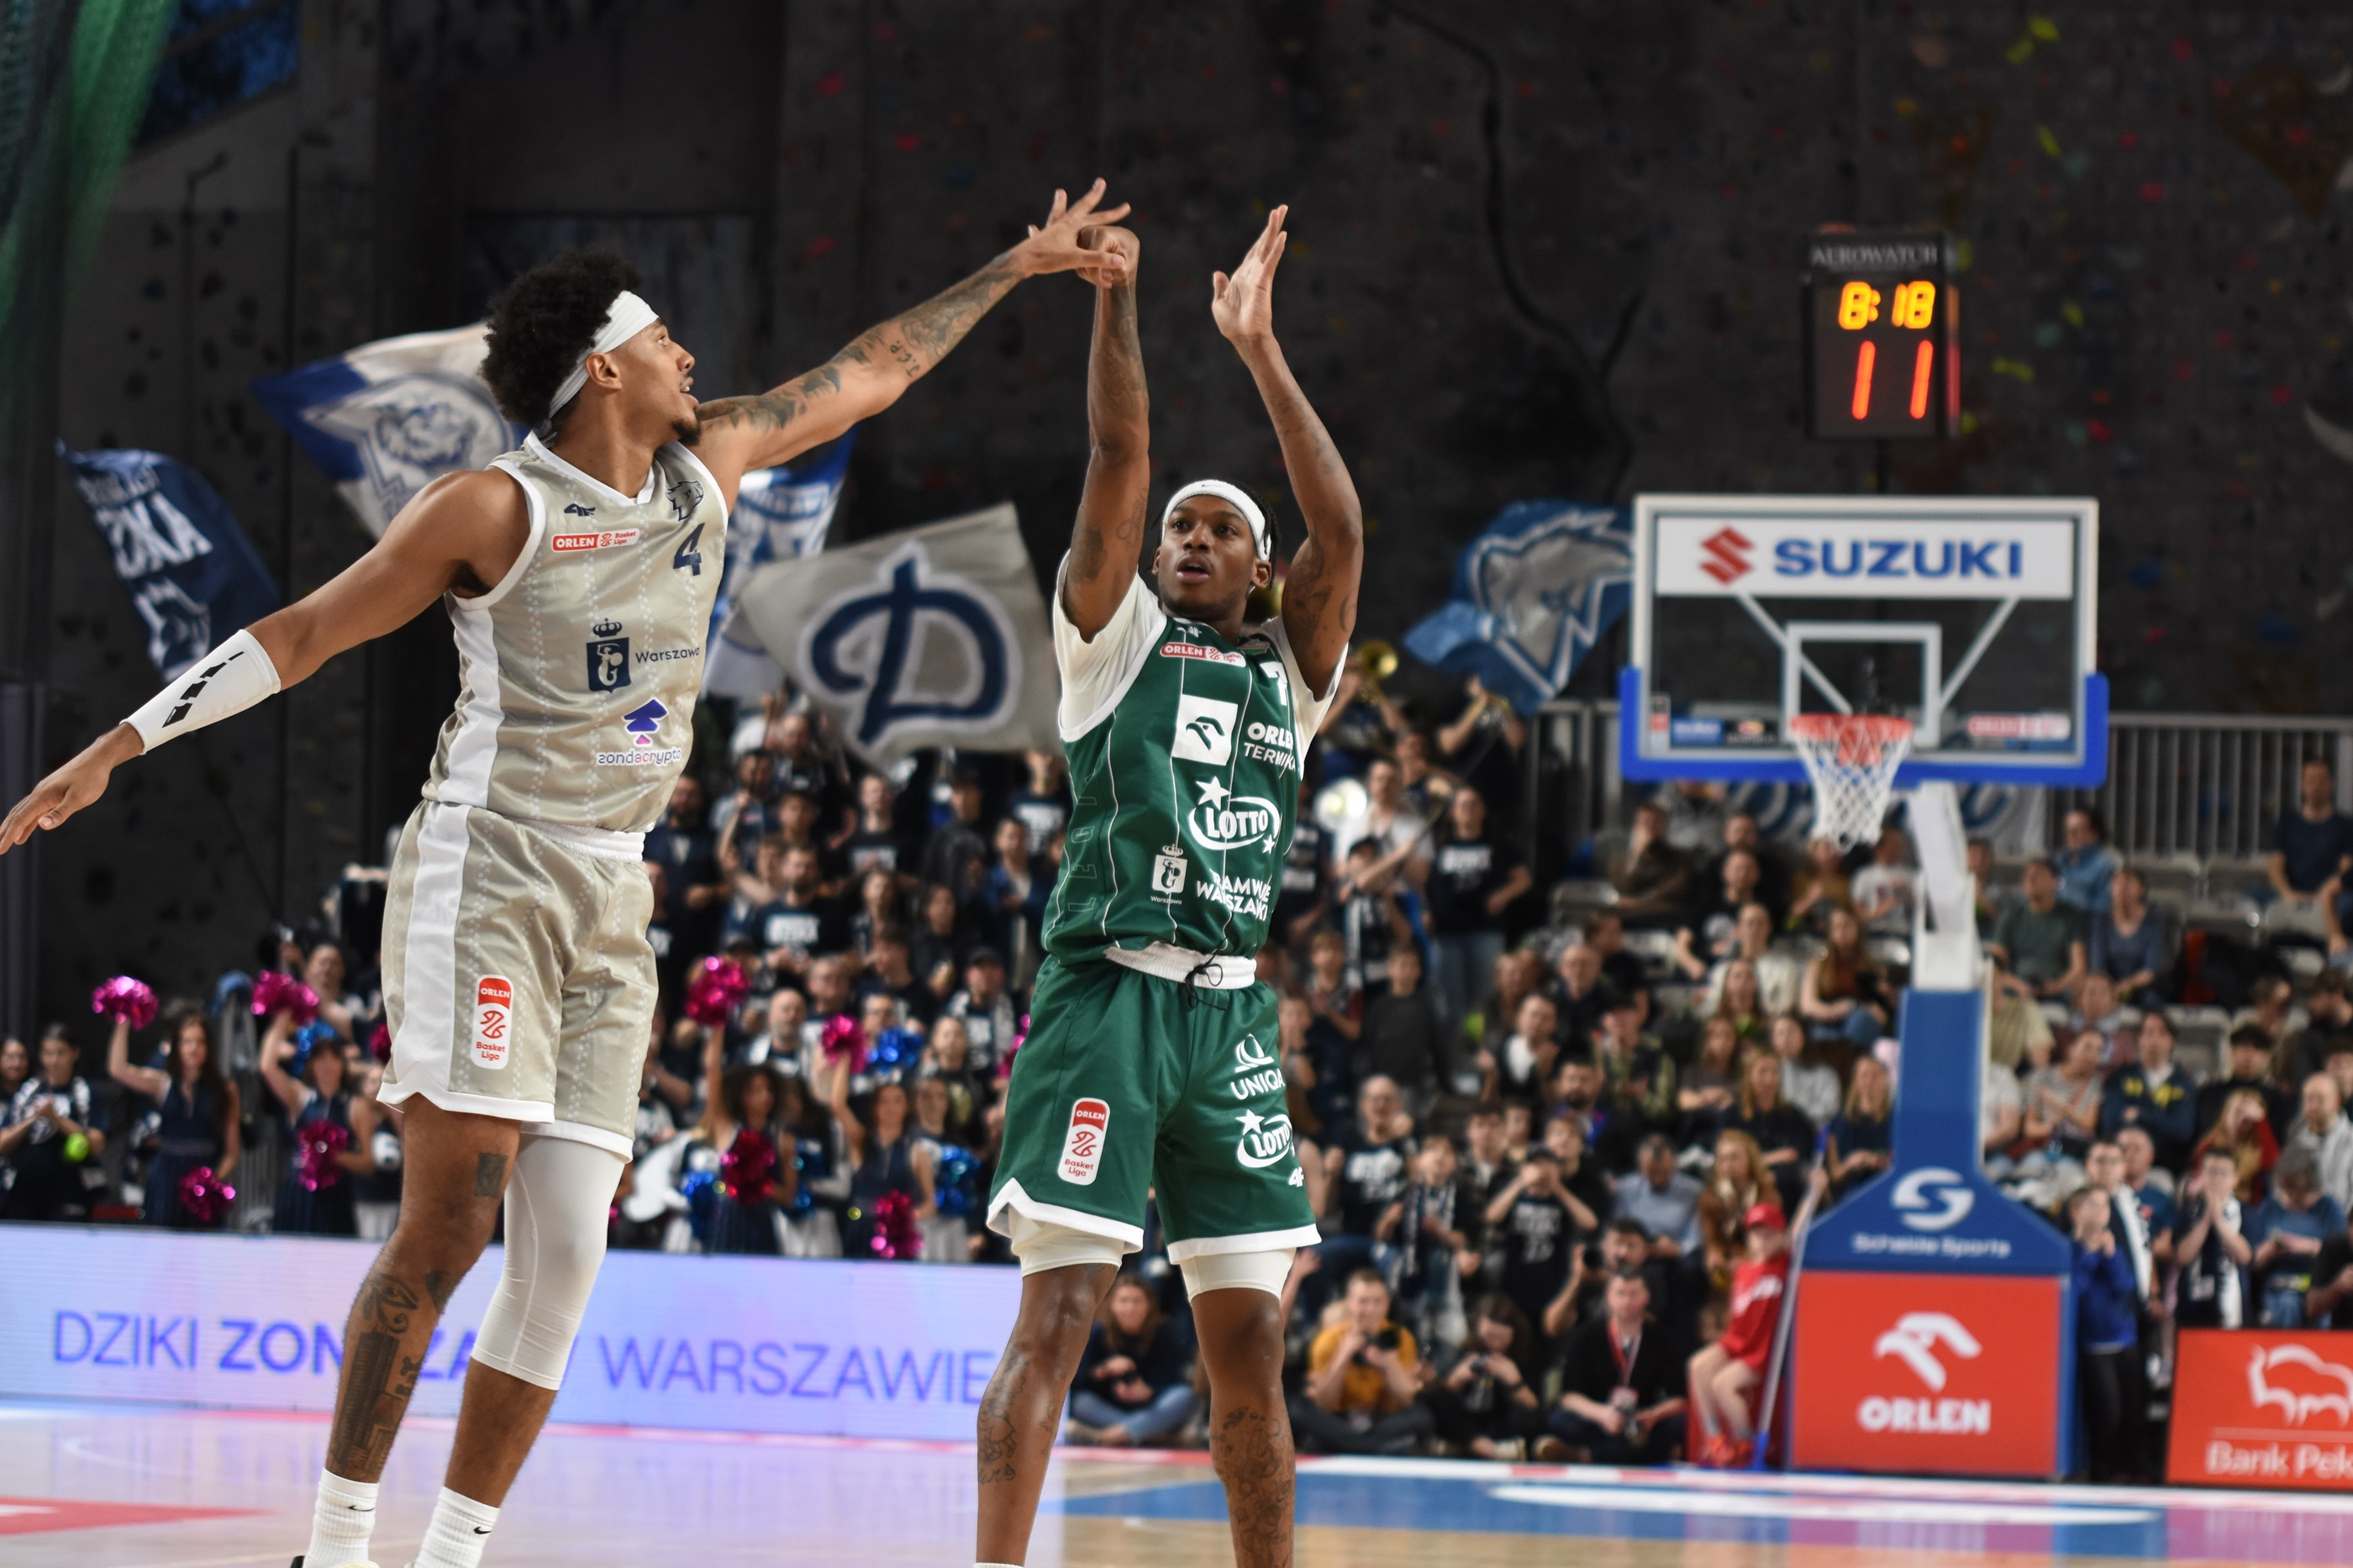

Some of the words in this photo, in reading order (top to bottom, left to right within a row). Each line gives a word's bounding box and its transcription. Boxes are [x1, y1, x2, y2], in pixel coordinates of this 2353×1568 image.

[1838, 281, 1936, 330] 8:18
[1851, 339, 1934, 420] 11
[555, 536, 595, 549] ORLEN
[613, 538, 628, 546] Liga
[673, 523, 706, 576] 4
[1773, 539, 2023, 578] SUZUKI
[635, 647, 700, 664] Warszawa
[1164, 645, 1203, 657] ORLEN
[1247, 722, 1294, 750] ORLE
[597, 749, 682, 765] zondacrypto
[1206, 807, 1269, 839] LOTTO
[1150, 895, 1182, 905] Warszawa
[480, 987, 511, 998] ORLEN
[476, 1041, 506, 1052] Basket
[481, 1050, 500, 1060] Liga
[1230, 1068, 1286, 1100] UNIQA
[1076, 1110, 1105, 1120] ORLEN
[1250, 1123, 1291, 1158] LOTTO
[1065, 1159, 1094, 1170] Basket
[1068, 1166, 1087, 1176] Liga
[54, 1310, 197, 1369] DZIKI
[598, 1334, 997, 1405] WARSZAWIE
[1856, 1395, 1992, 1435] ORLEN
[2205, 1439, 2290, 1476] Bank
